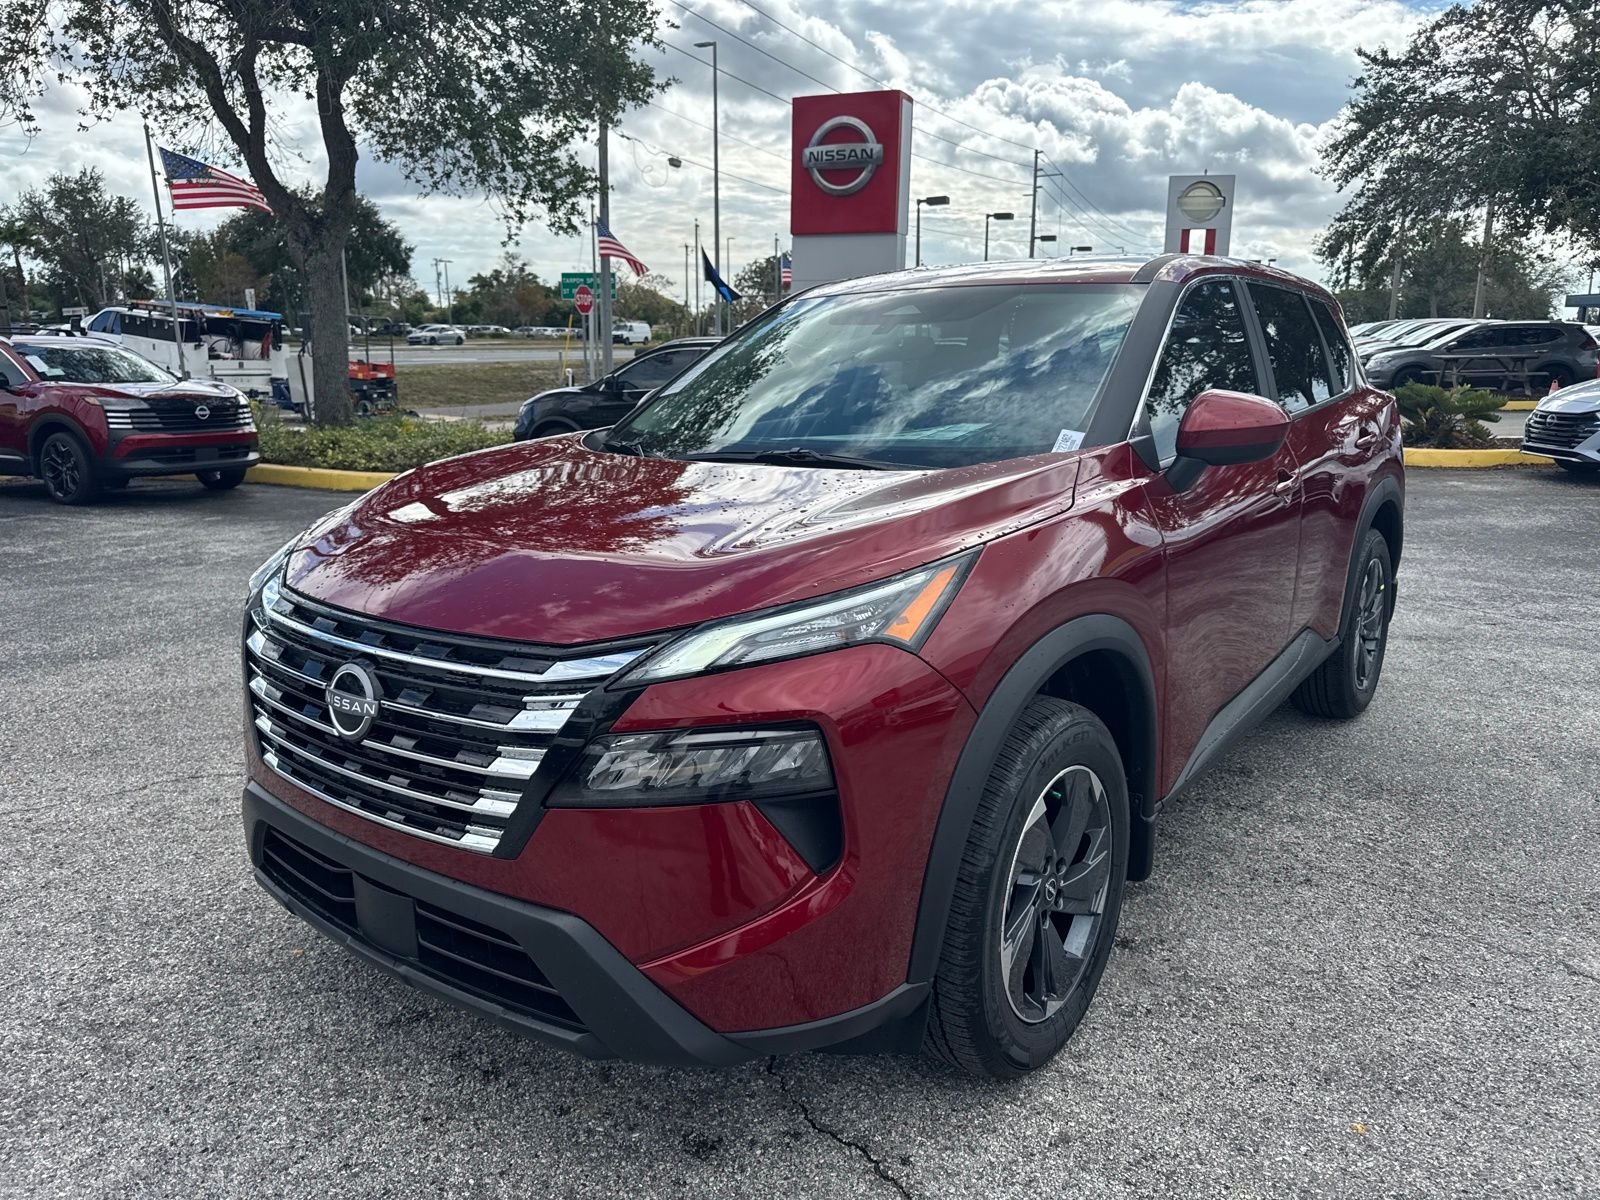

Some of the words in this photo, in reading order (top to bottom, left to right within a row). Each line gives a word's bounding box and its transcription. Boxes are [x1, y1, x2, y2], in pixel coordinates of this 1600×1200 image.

[808, 148, 874, 162] NISSAN
[576, 294, 593, 305] STOP
[326, 690, 376, 715] NISSAN
